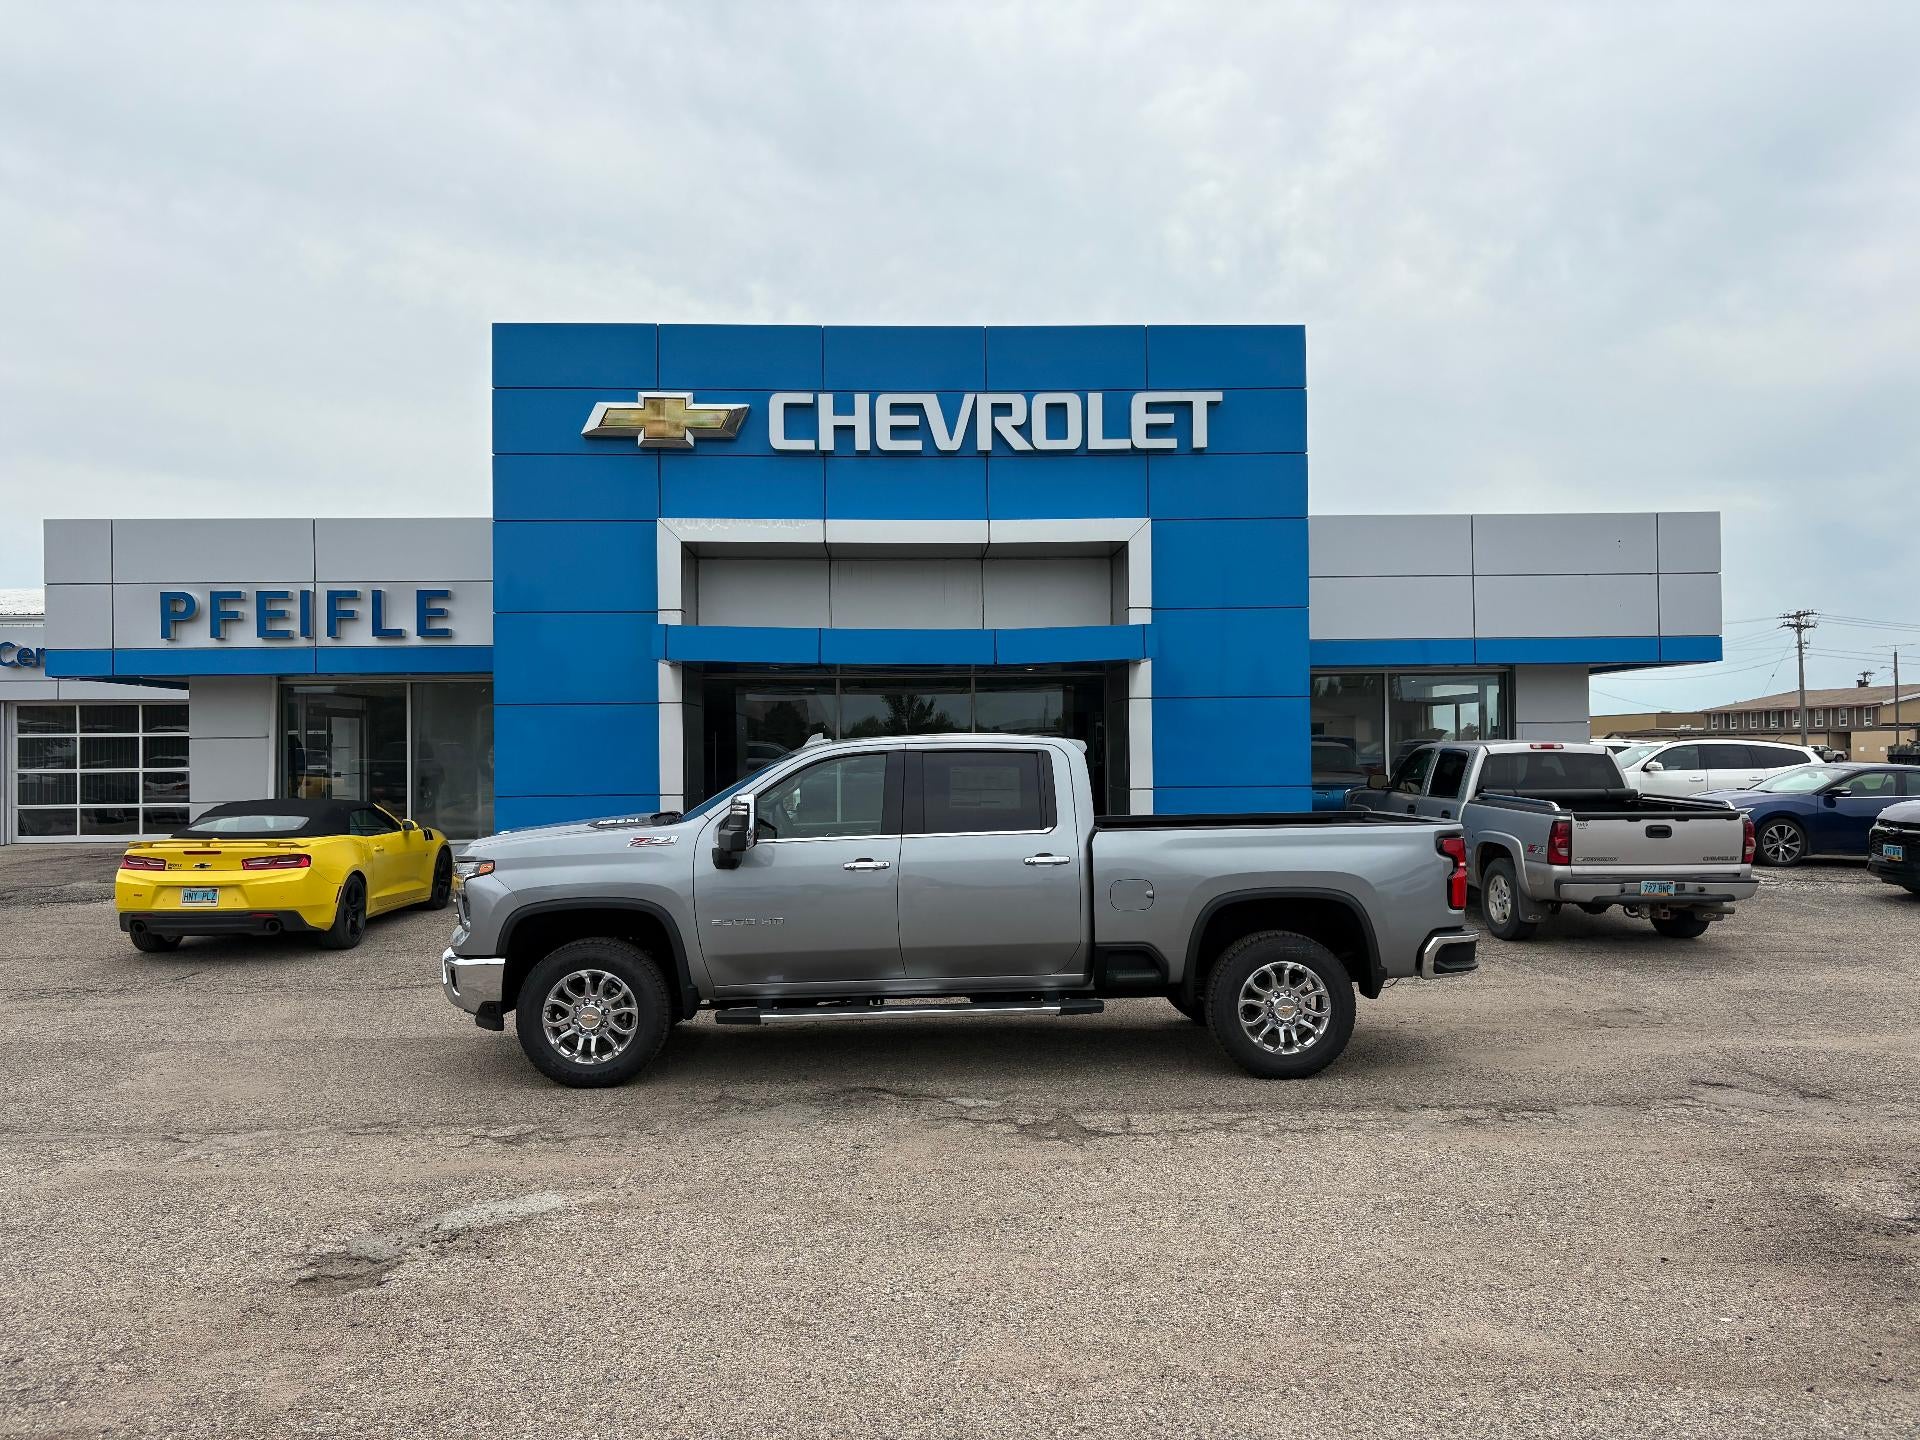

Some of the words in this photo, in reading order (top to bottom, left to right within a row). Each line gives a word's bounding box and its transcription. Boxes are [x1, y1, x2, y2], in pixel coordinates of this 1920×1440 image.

[767, 391, 1223, 451] CHEVROLET
[160, 588, 453, 640] PFEIFLE
[183, 892, 198, 901] HNY
[201, 892, 217, 901] PLZ
